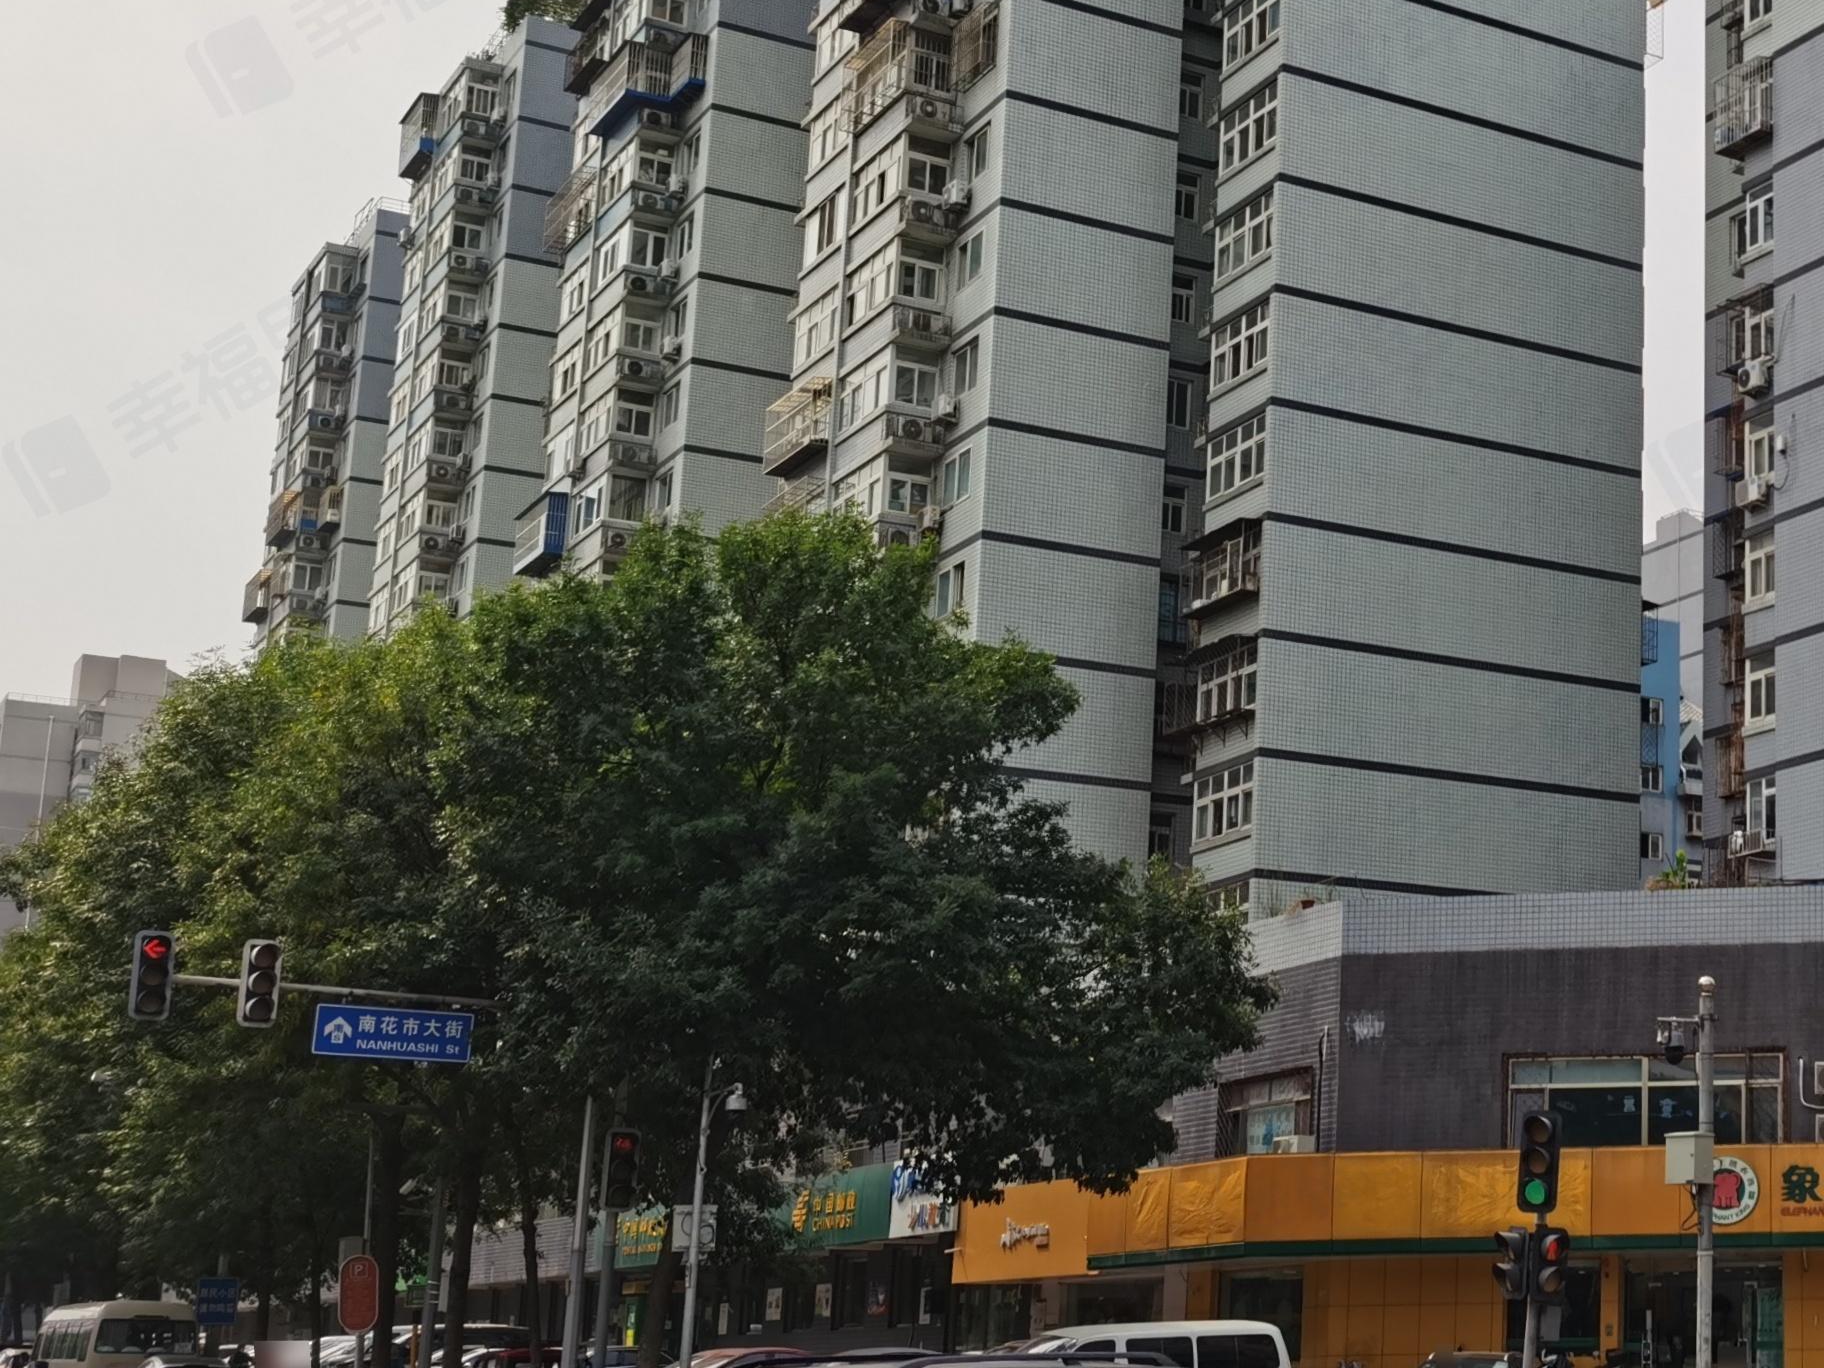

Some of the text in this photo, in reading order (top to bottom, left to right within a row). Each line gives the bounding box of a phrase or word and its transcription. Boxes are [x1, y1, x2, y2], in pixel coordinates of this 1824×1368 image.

[358, 1015, 464, 1039] 南花市大街
[356, 1039, 460, 1055] NANHUASHI St
